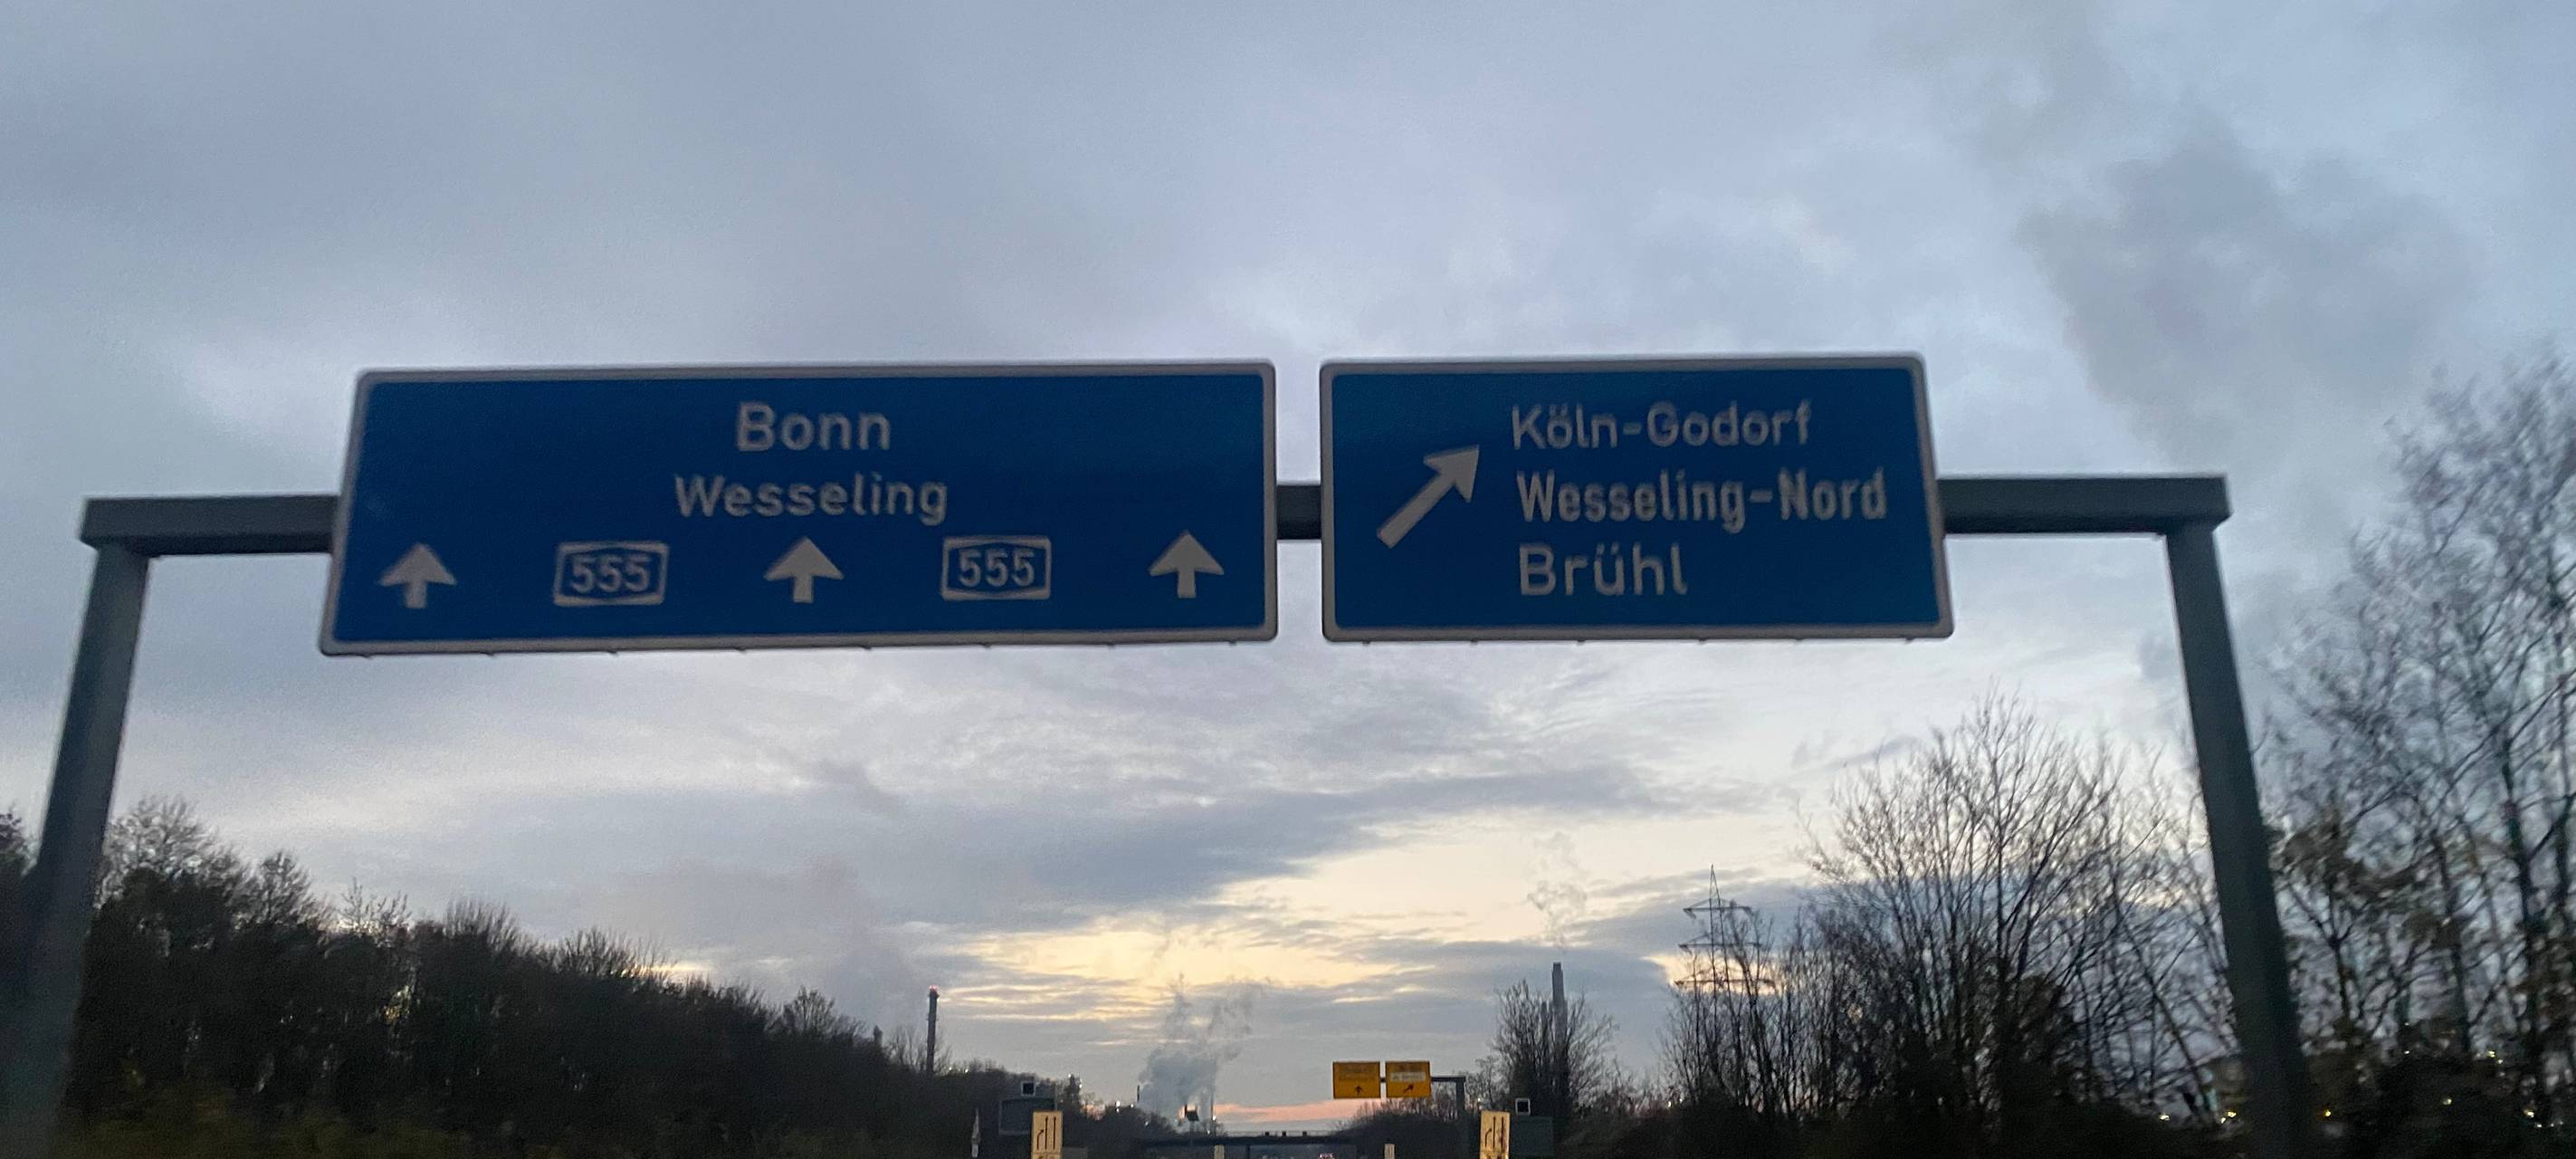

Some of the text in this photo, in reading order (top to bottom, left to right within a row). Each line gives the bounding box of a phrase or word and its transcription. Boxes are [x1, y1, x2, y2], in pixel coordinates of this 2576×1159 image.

[735, 399, 891, 451] Bonn
[1512, 399, 1811, 450] Köln-Godorf
[674, 471, 948, 525] Wesseling
[1515, 466, 1888, 534] Wesseling-Nord
[570, 554, 652, 594] 555
[959, 548, 1035, 588] 555
[1519, 542, 1688, 596] Brühl
